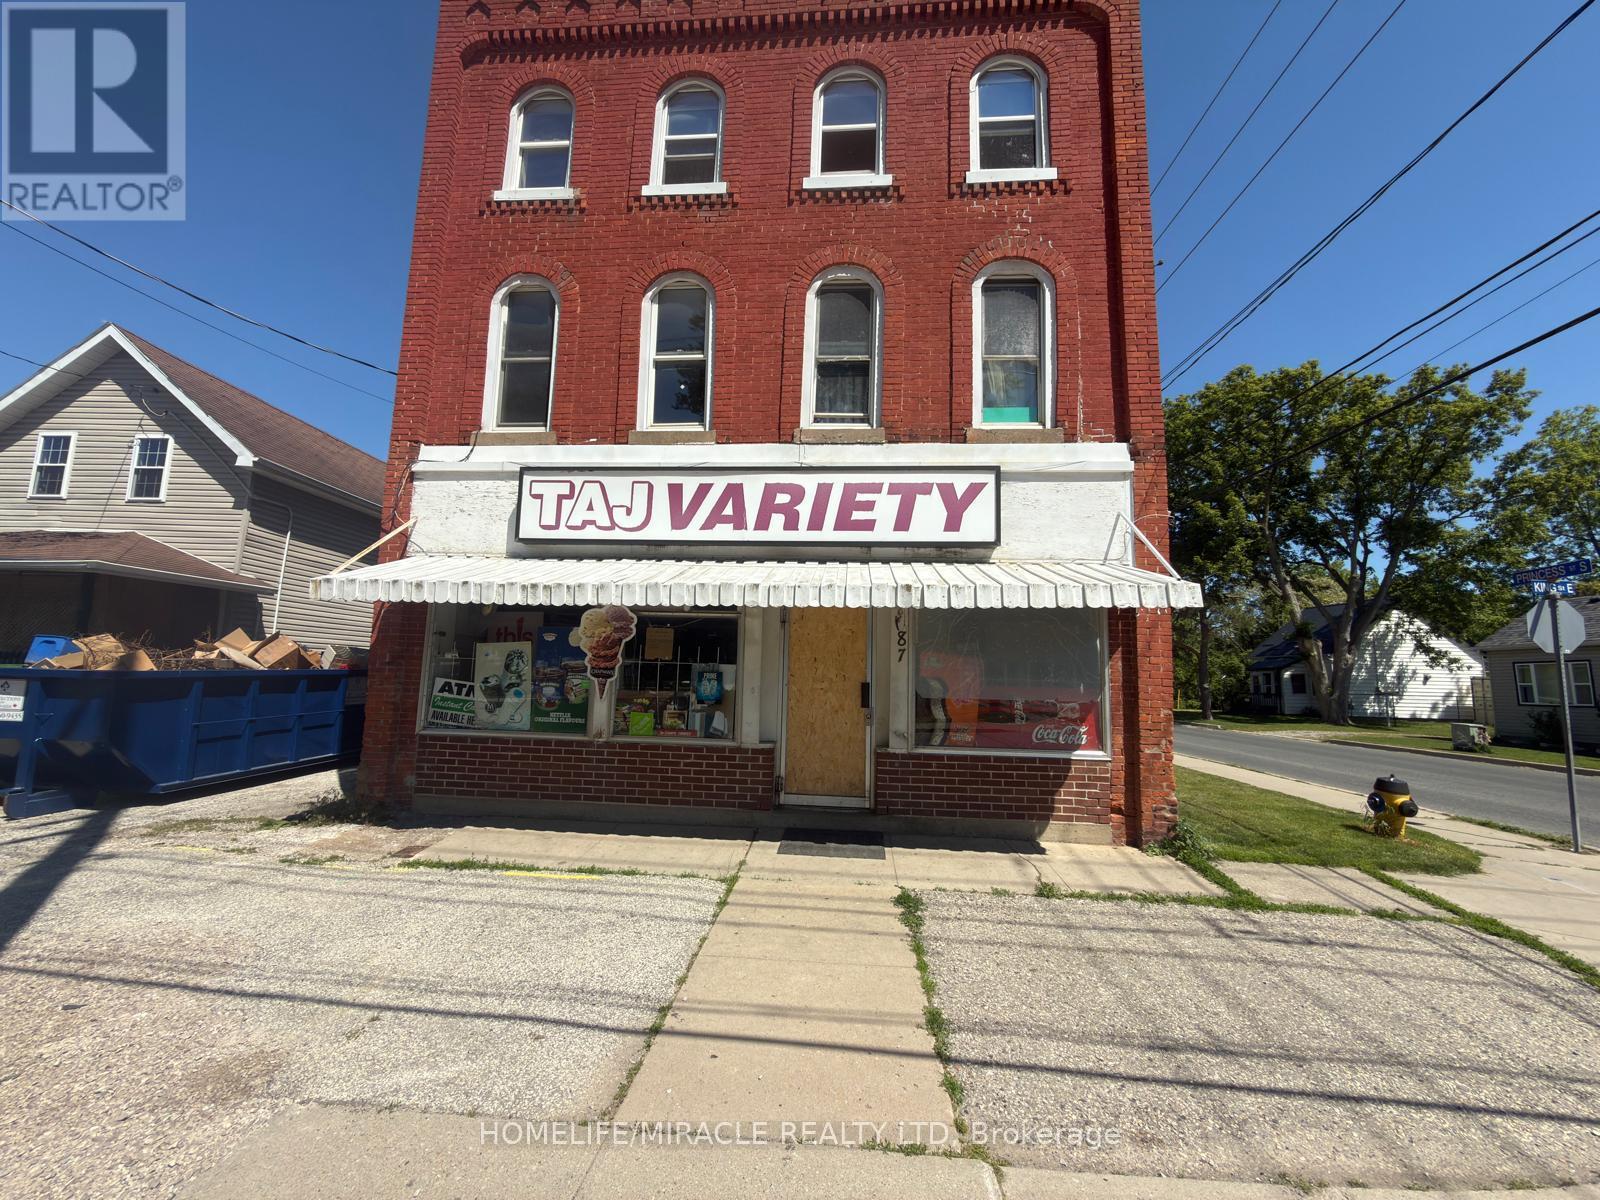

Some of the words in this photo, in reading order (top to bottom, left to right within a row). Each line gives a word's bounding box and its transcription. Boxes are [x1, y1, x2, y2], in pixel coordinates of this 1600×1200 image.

[530, 479, 654, 532] TAJ
[667, 482, 988, 532] VARIETY
[1516, 565, 1566, 583] PRINCESS
[1579, 561, 1588, 572] S
[1533, 582, 1557, 592] KING
[1566, 583, 1574, 594] E
[431, 710, 465, 724] AVAILABLE
[1032, 724, 1088, 745] Coca-Cola
